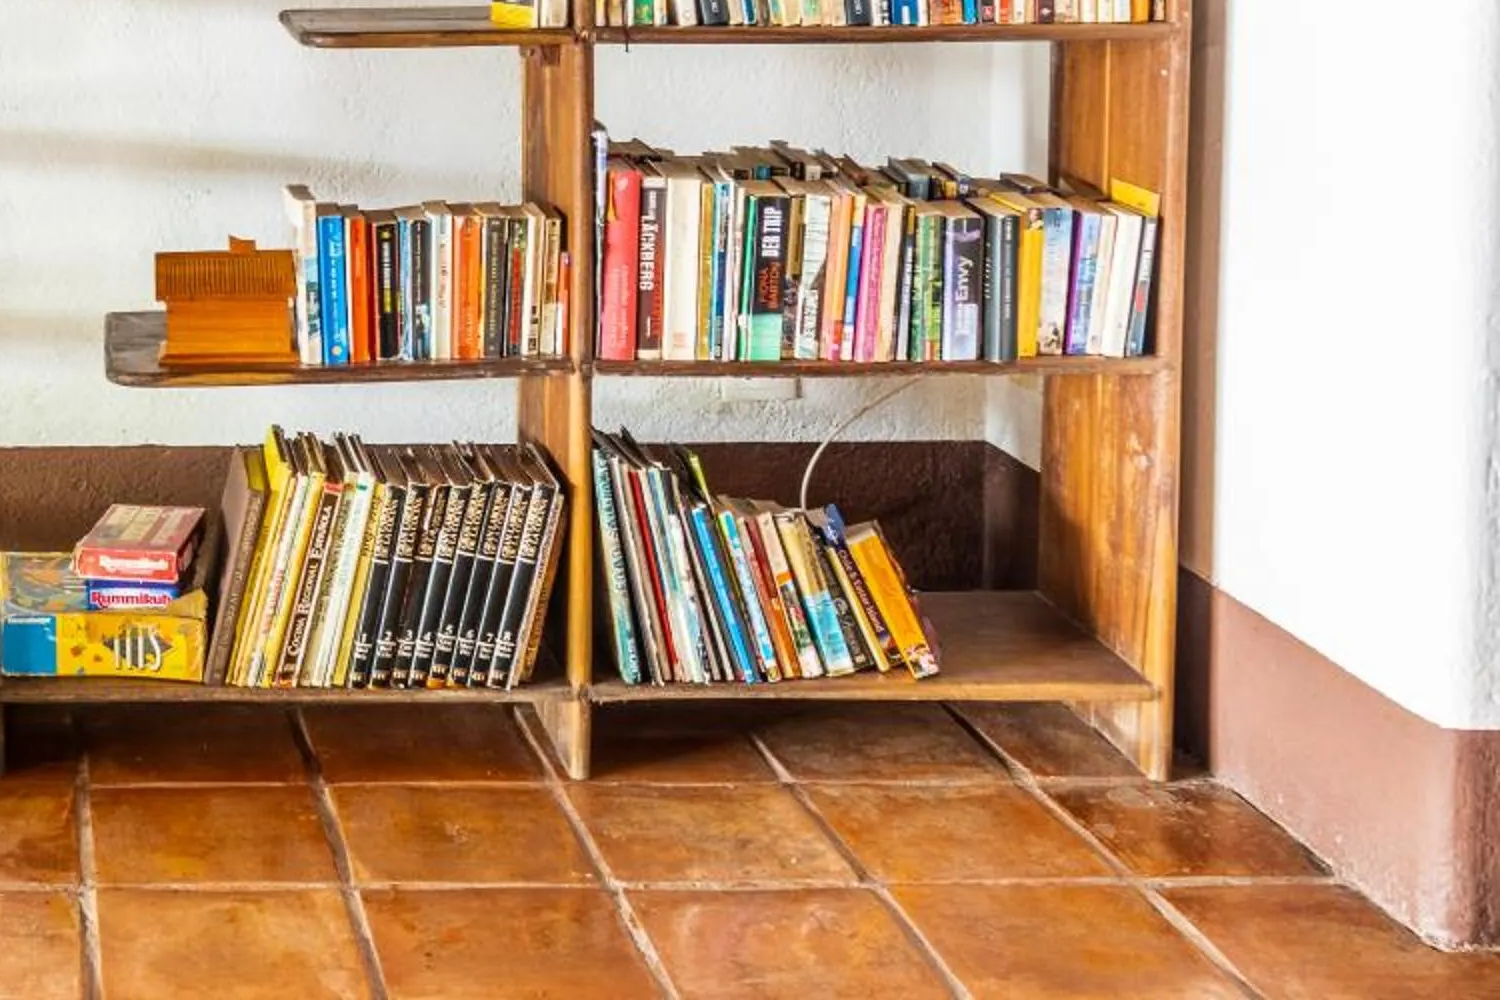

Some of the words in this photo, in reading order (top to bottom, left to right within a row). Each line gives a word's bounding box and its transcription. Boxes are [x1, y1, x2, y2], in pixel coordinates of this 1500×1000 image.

[763, 206, 781, 232] TRIP
[638, 214, 658, 290] LÄCKBERG
[761, 234, 780, 257] DER
[954, 255, 973, 301] Envy
[865, 604, 885, 634] Island
